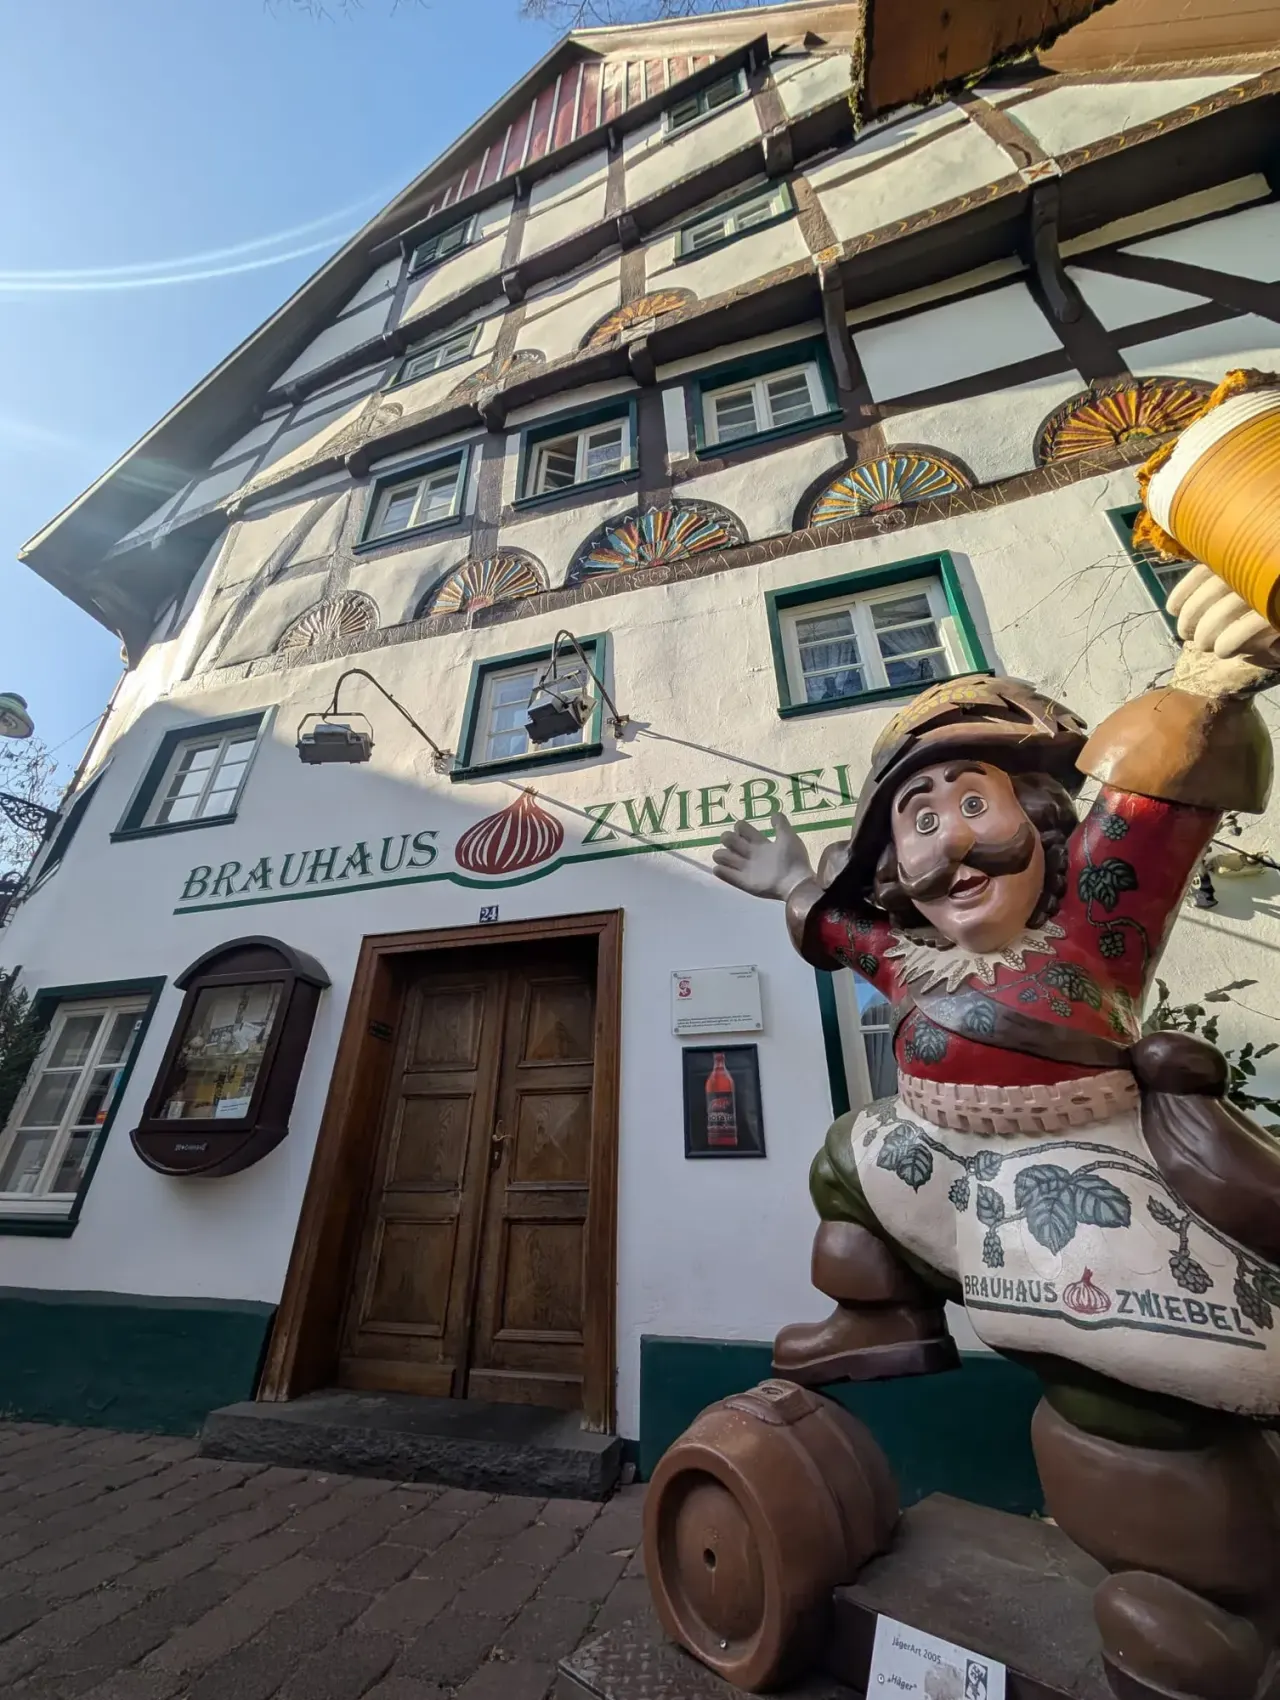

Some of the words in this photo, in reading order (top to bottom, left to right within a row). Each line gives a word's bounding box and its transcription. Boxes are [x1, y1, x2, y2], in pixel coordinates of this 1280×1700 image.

[178, 830, 440, 901] BRAUHAUS
[581, 763, 861, 846] ZWIEBEL
[481, 906, 497, 921] 24
[963, 1274, 1059, 1304] BRAUHAUS
[1115, 1288, 1256, 1337] ZWIEBEL
[891, 1636, 922, 1657] JägerArt
[922, 1648, 942, 1665] 2005
